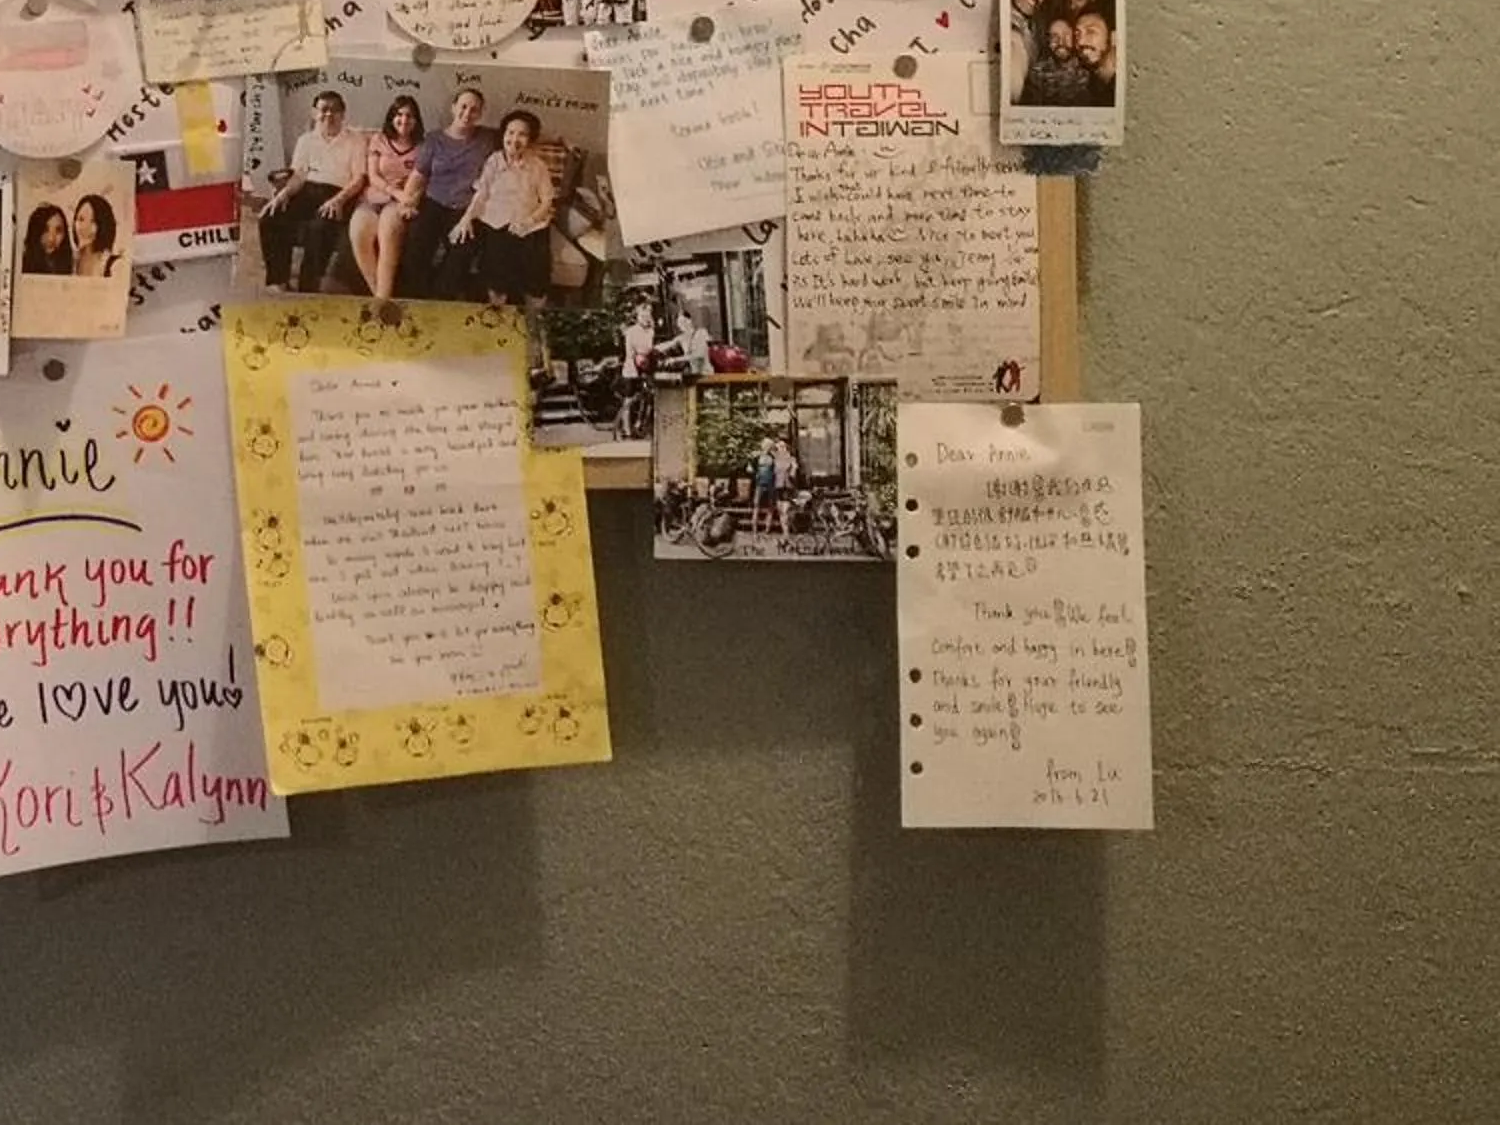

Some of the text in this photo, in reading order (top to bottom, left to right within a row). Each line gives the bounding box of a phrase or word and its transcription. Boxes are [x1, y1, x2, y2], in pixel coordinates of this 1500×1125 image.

[85, 556, 155, 608] you
[162, 538, 215, 585] for
[119, 740, 268, 826] Kalynn
